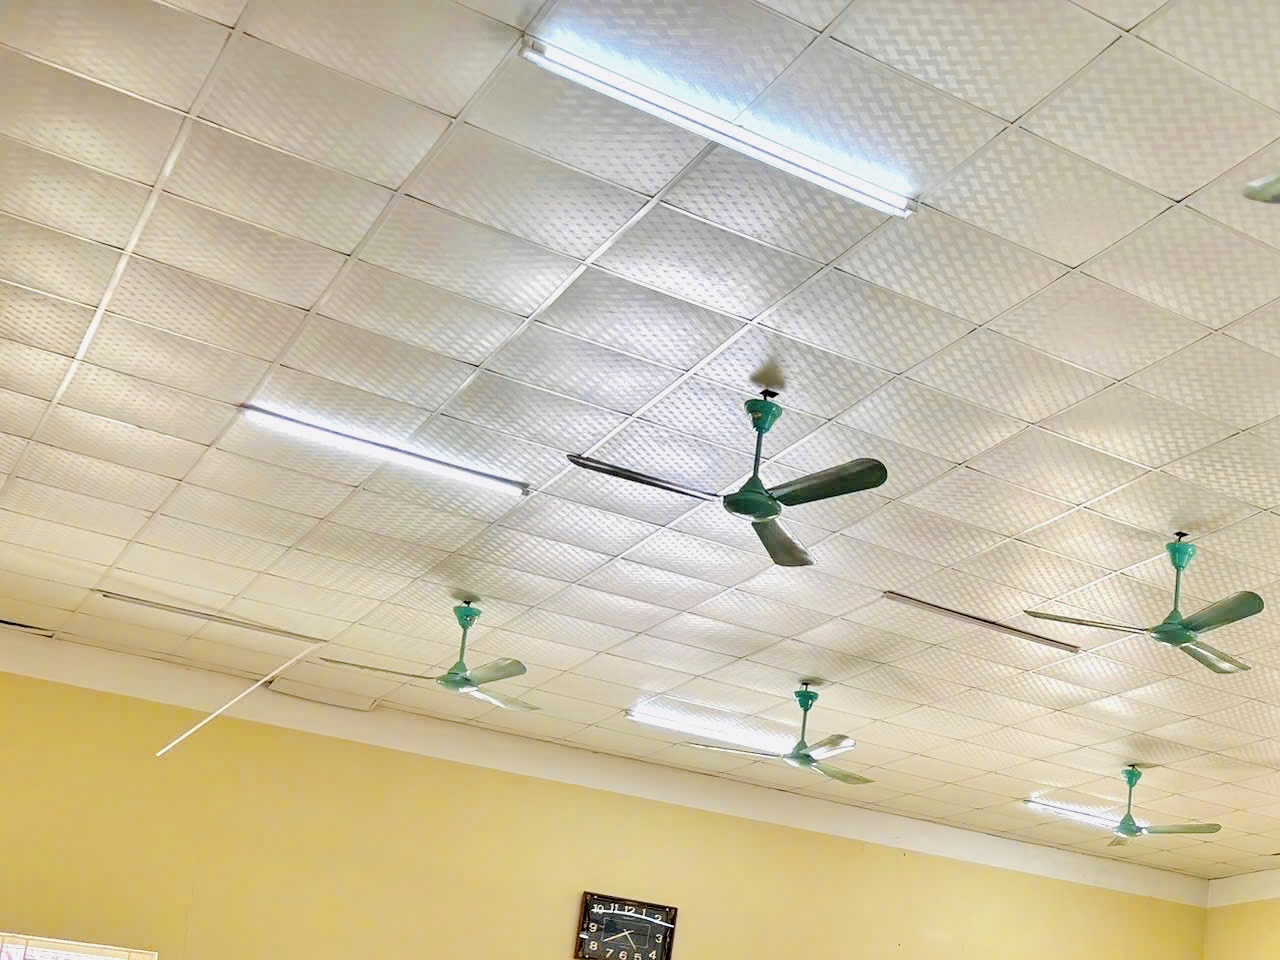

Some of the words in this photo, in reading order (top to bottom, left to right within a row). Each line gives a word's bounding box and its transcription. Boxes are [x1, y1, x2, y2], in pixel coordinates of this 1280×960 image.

[624, 905, 636, 914] 12
[588, 922, 598, 932] 9
[655, 933, 663, 943] 3
[589, 940, 598, 951] 8
[605, 948, 614, 959] 7
[619, 950, 628, 960] 6
[648, 950, 657, 960] 4
